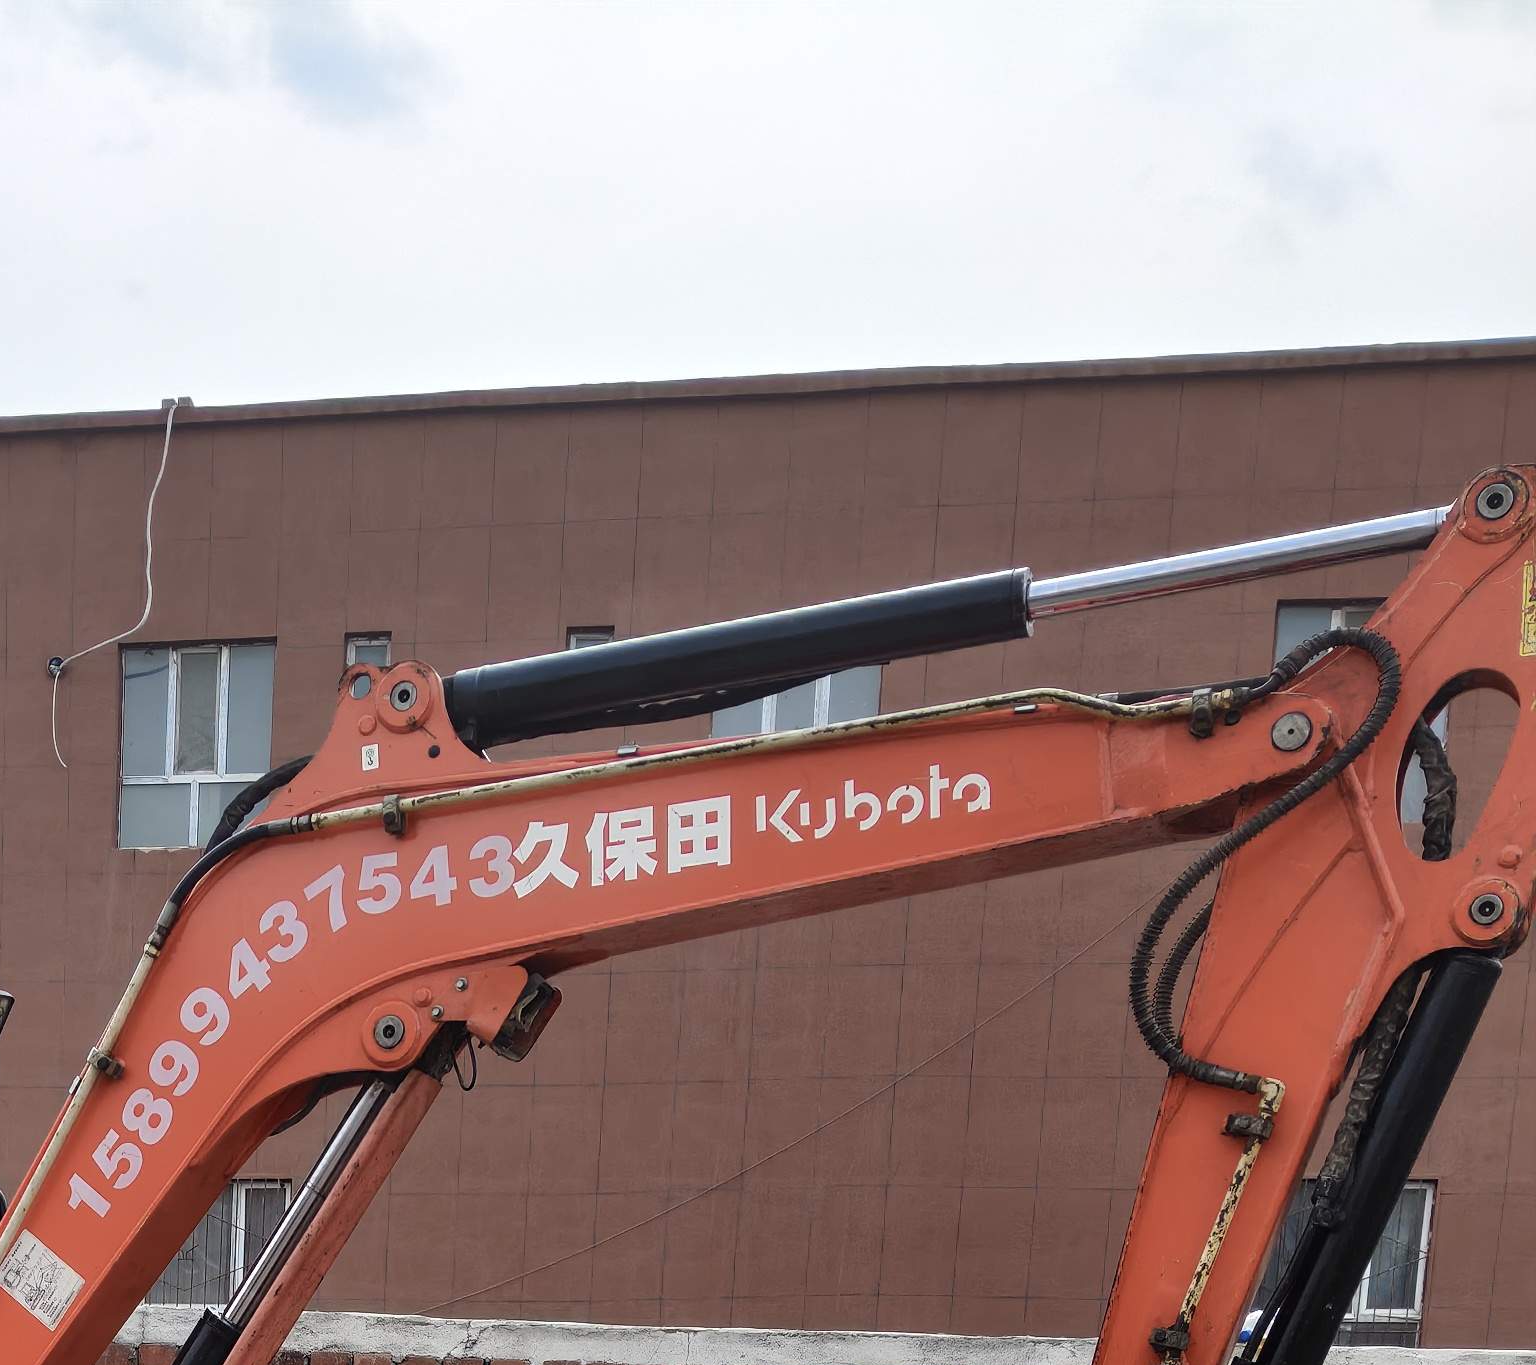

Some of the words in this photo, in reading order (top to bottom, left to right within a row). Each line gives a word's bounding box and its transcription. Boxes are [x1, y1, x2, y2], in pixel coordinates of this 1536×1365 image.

[512, 794, 732, 899] 久保田
[755, 764, 991, 843] Kubota
[68, 836, 516, 1217] 15899437543
